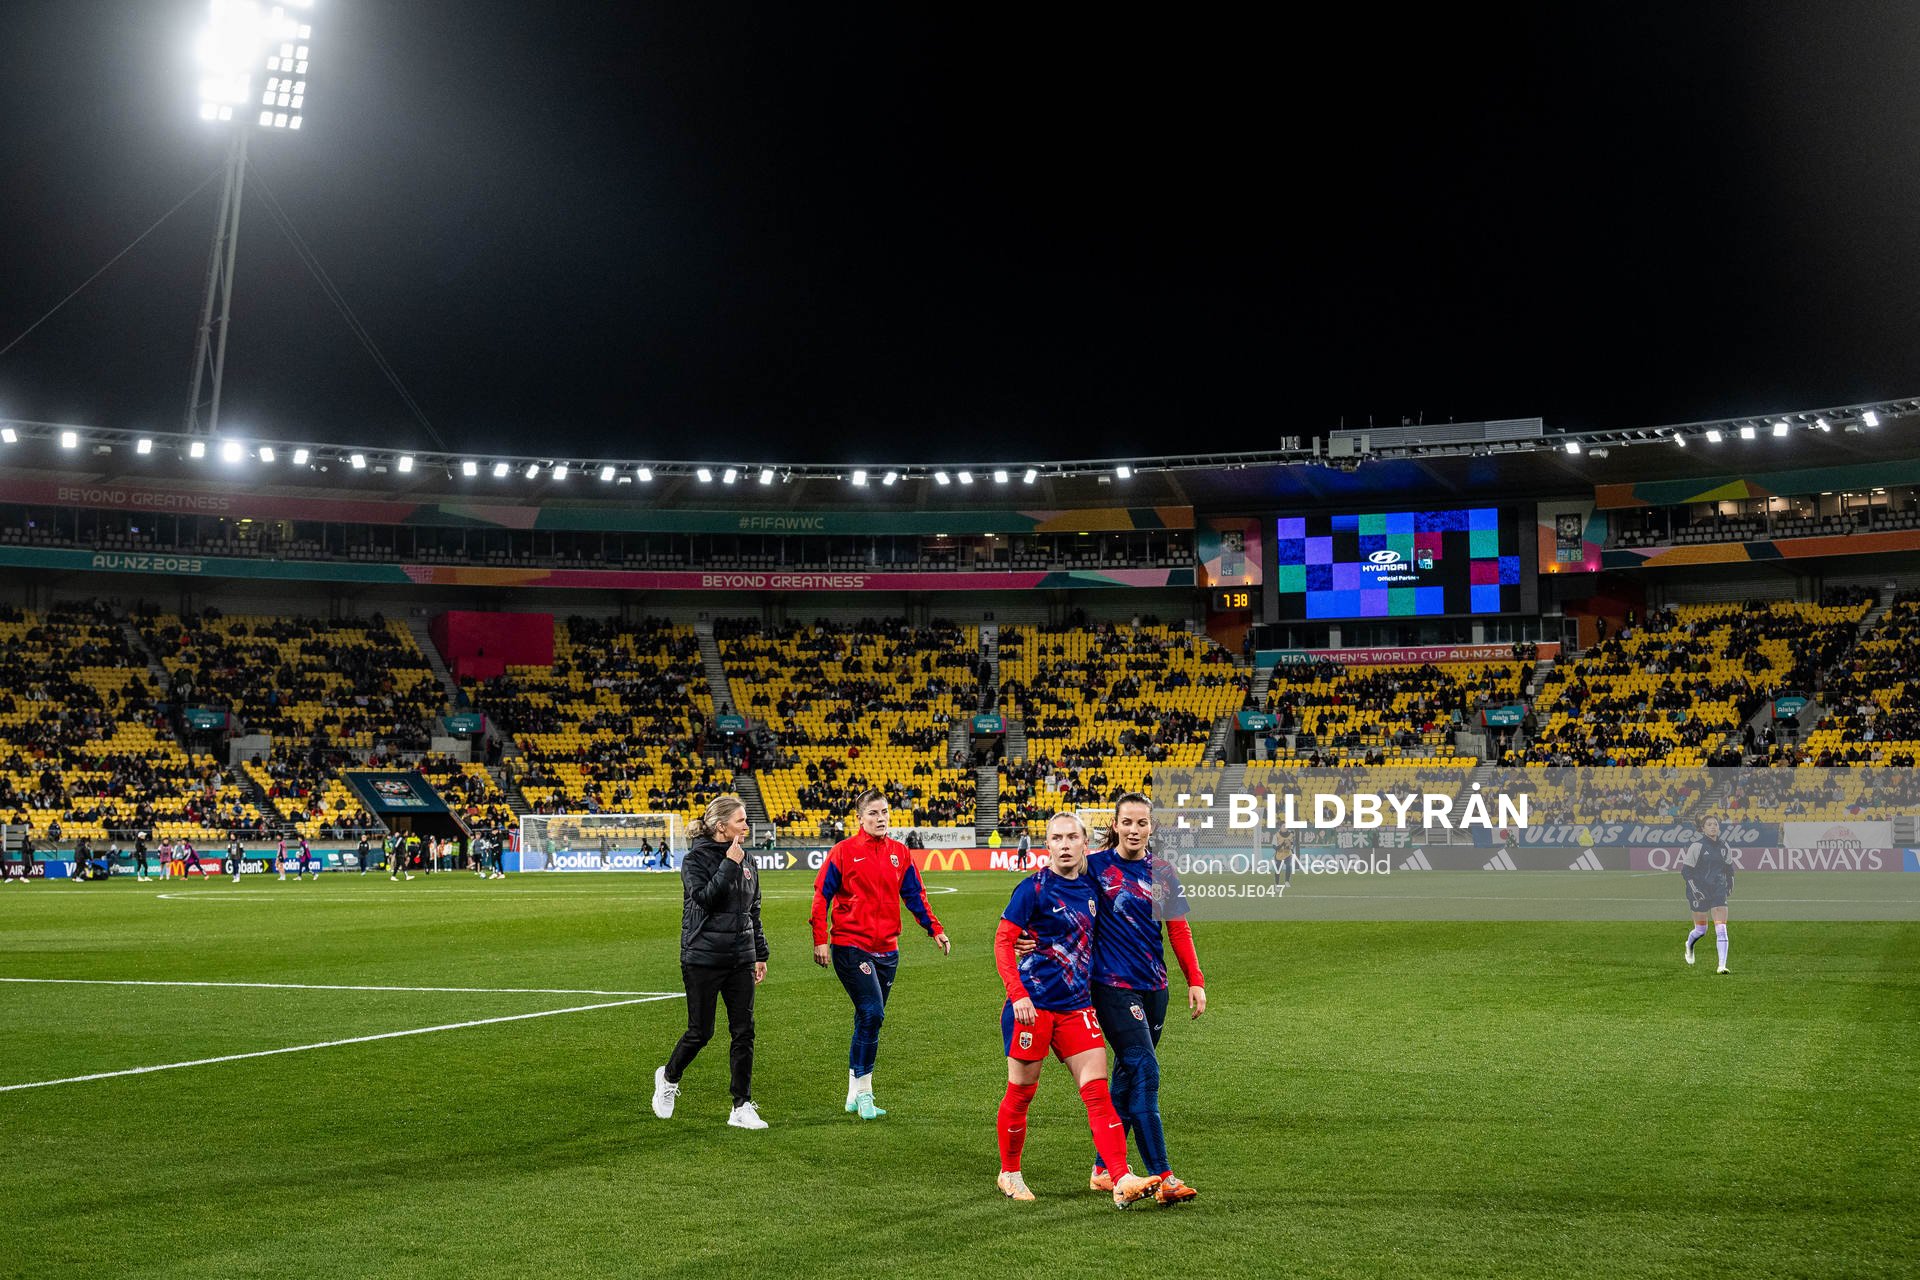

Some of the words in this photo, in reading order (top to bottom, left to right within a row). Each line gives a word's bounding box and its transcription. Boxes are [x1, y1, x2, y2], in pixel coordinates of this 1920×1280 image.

[57, 487, 126, 504] BEYOND
[131, 493, 230, 511] GREATNESS
[738, 517, 825, 530] #FIFAWWC
[1362, 563, 1408, 573] HYUNDAI
[702, 575, 767, 588] BEYOND
[1281, 654, 1307, 664] FIFA
[1308, 653, 1369, 663] WOMEN'S
[1372, 651, 1417, 661] WORLD
[1421, 651, 1447, 660] CUP
[1757, 848, 1883, 870] AIRWAYS
